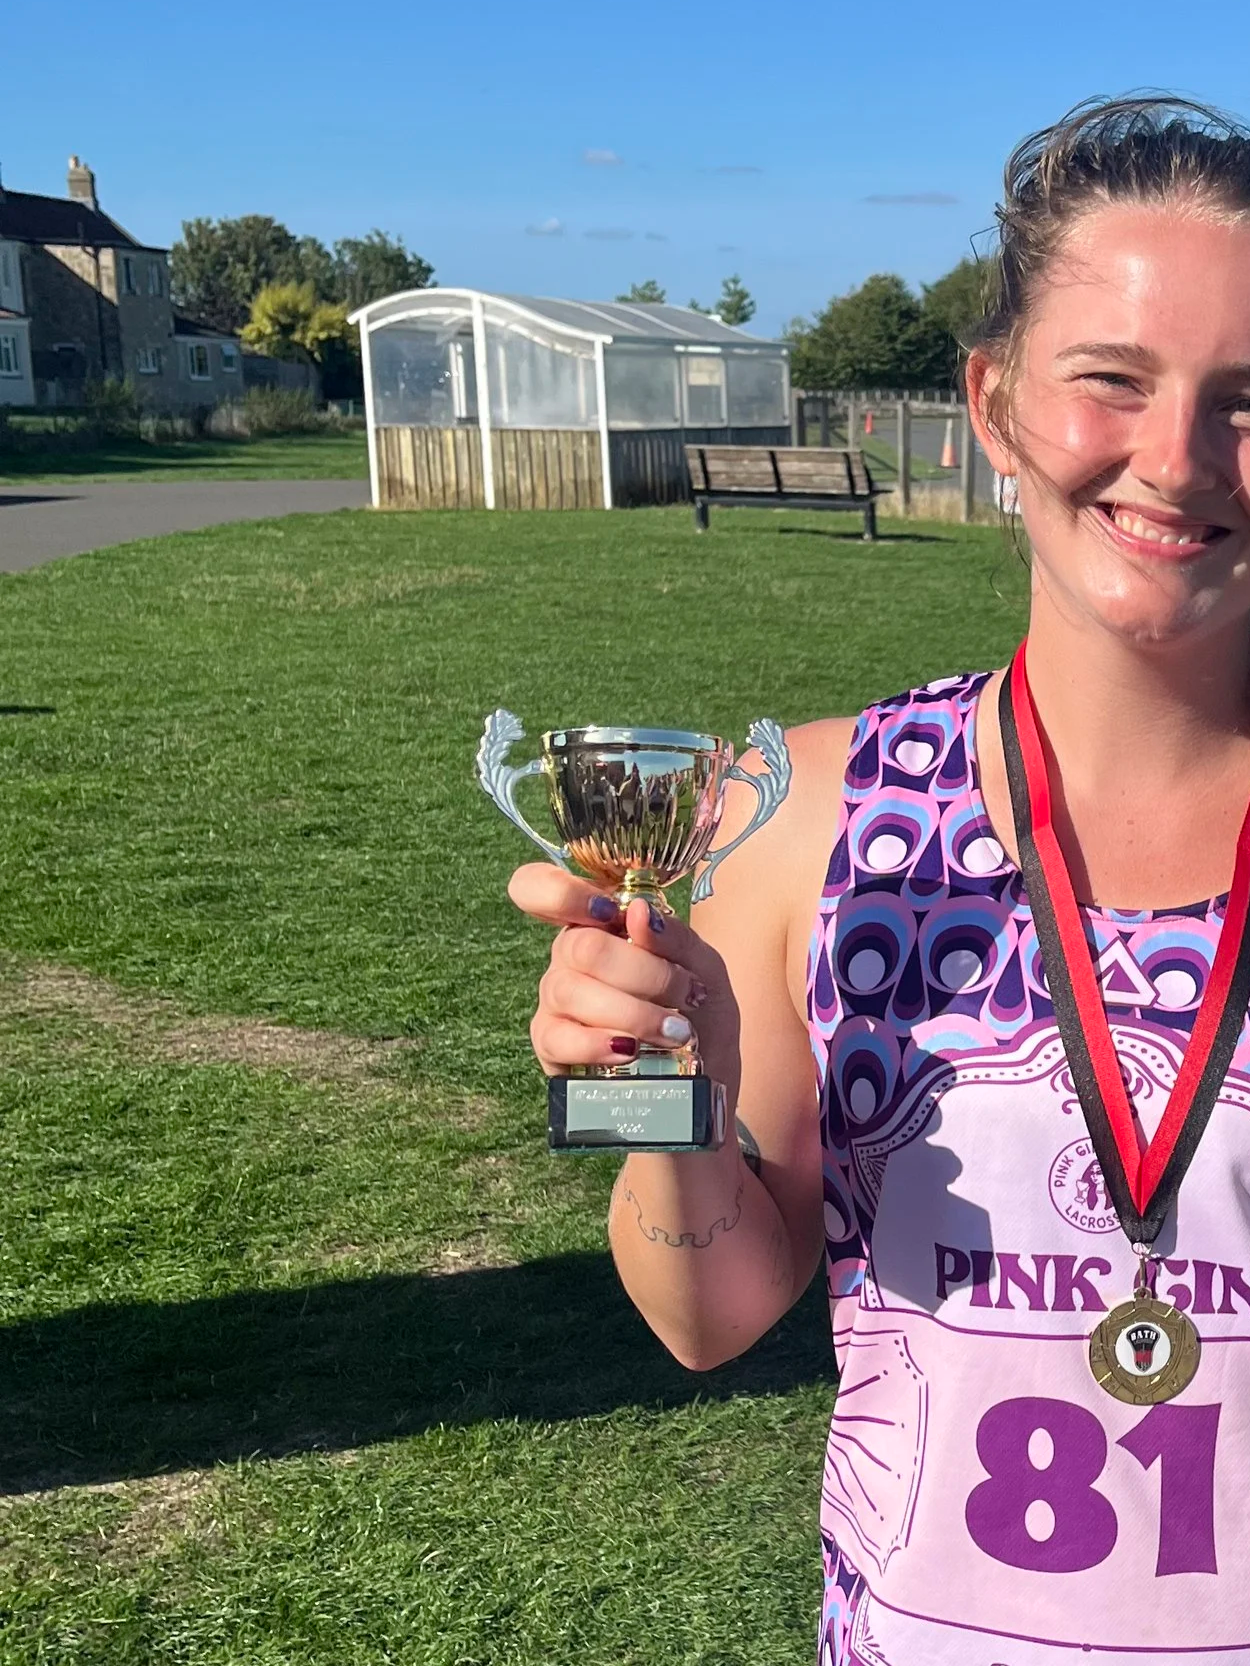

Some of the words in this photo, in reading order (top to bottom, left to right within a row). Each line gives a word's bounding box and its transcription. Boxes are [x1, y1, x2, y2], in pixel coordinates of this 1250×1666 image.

[1054, 1155, 1074, 1187] PINK
[1075, 1143, 1095, 1157] GI
[1065, 1204, 1120, 1229] LACROSS
[934, 1242, 1112, 1313] PINK
[1130, 1330, 1157, 1341] BATH
[965, 1396, 1221, 1577] 81
